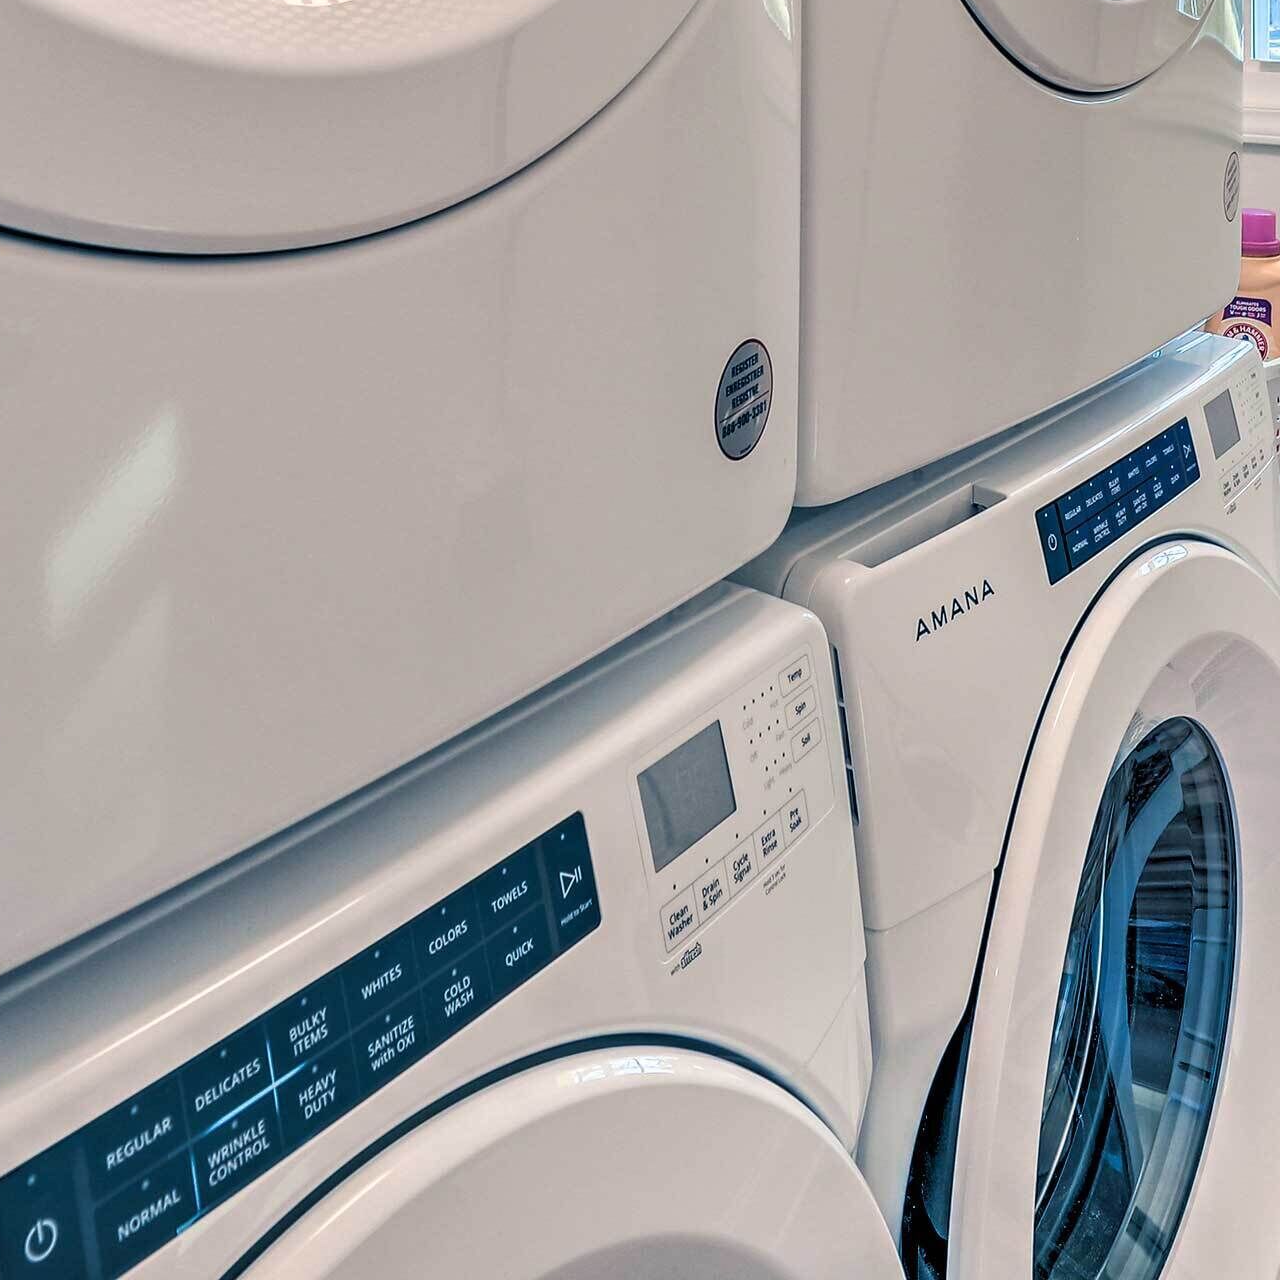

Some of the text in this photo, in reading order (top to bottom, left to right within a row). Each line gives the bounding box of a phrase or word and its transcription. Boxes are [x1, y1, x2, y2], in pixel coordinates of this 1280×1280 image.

[916, 579, 995, 642] AMANA
[761, 829, 775, 846] Extra
[762, 840, 777, 857] Rinse
[733, 853, 748, 871] Cycle
[734, 862, 751, 884] Signal
[491, 881, 528, 913] TOWELS
[702, 878, 720, 898] Drain
[703, 889, 723, 911] & Spin
[667, 914, 693, 940] Washer
[669, 905, 688, 925] Clean
[428, 921, 469, 955] COLORS
[506, 937, 533, 967] QUICK
[362, 965, 402, 1000] WHITES
[444, 975, 471, 1003] COLD
[445, 987, 474, 1018] WASH
[289, 1007, 327, 1043] BULKY
[293, 1024, 328, 1058] ITEMS
[367, 1016, 415, 1058] SANITIZE
[371, 1032, 415, 1072] with OXI
[195, 1058, 261, 1112] DELICATES
[298, 1070, 338, 1106] HEAVY
[304, 1087, 336, 1119] DUTY
[106, 1117, 172, 1170] REGULAR
[208, 1119, 266, 1170] WRINKLE
[209, 1137, 270, 1187] CONTROL
[117, 1189, 181, 1243] NORMAL
